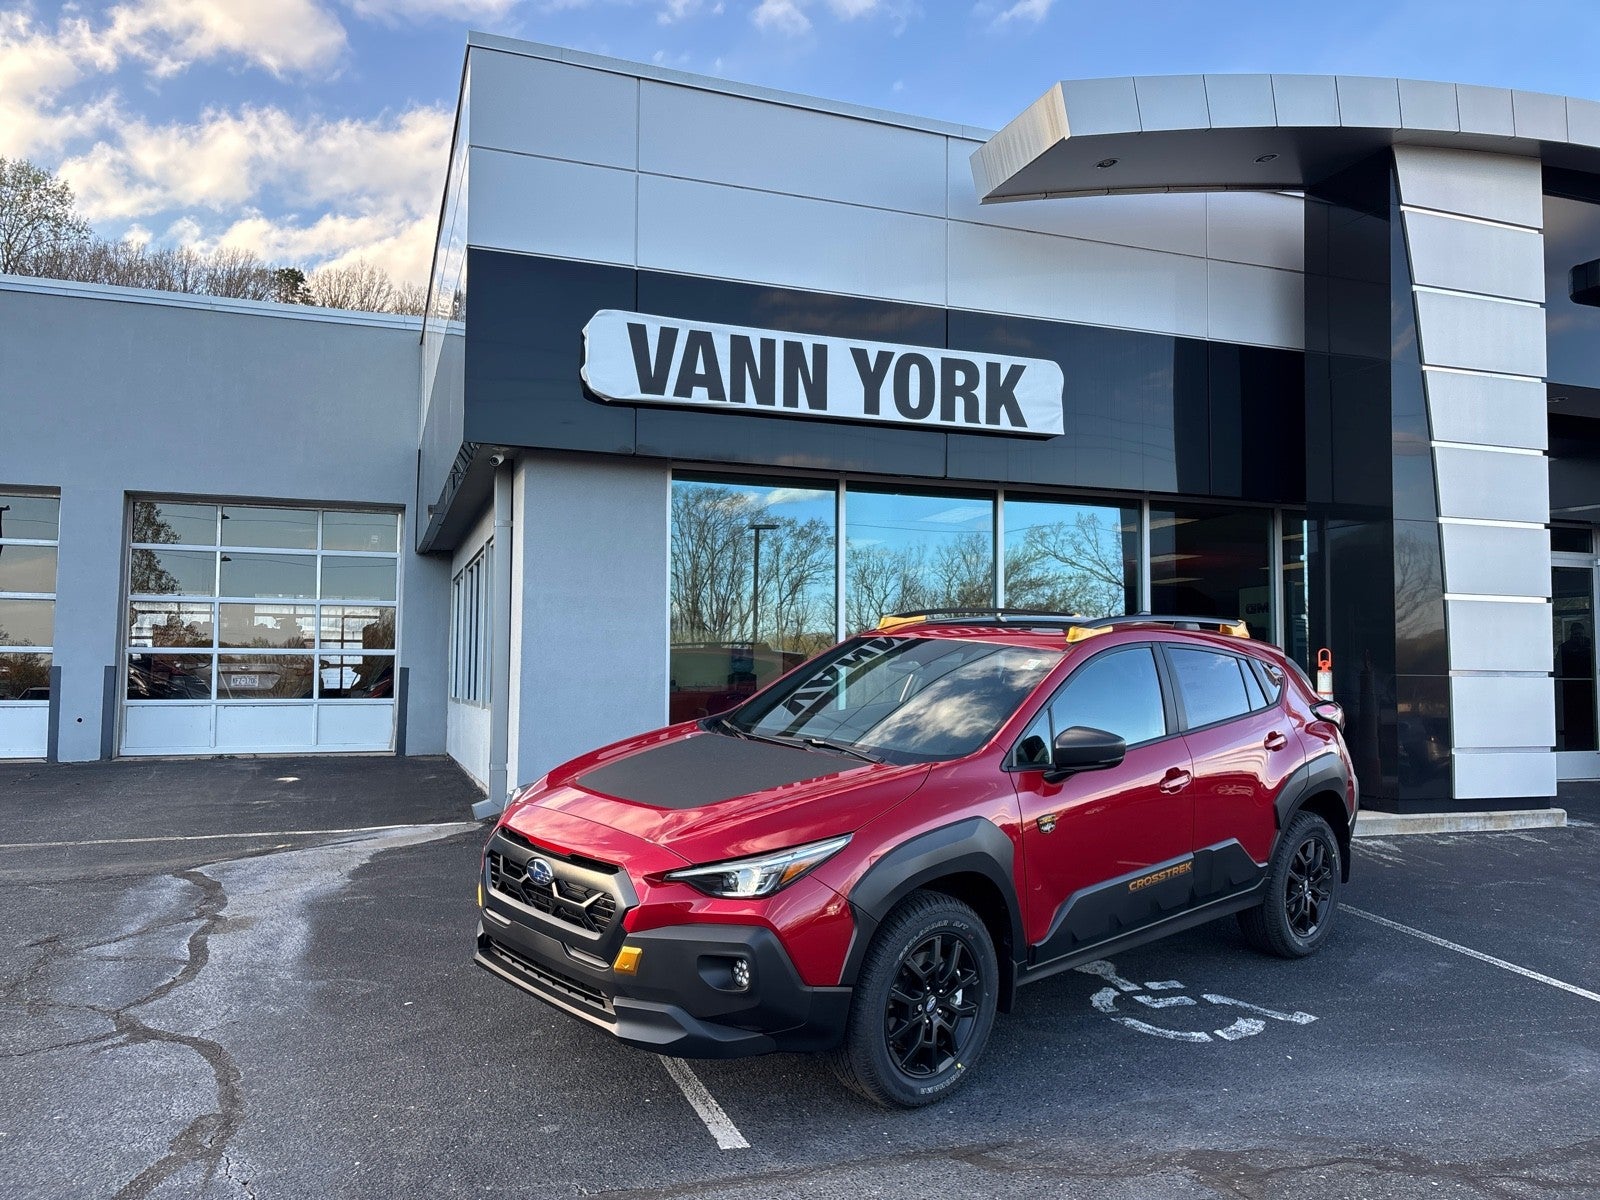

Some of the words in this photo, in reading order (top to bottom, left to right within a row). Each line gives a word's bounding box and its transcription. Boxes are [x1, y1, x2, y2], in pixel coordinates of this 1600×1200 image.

[626, 322, 828, 411] VANN
[850, 347, 1029, 429] YORK
[1128, 861, 1192, 891] CROSSTREK
